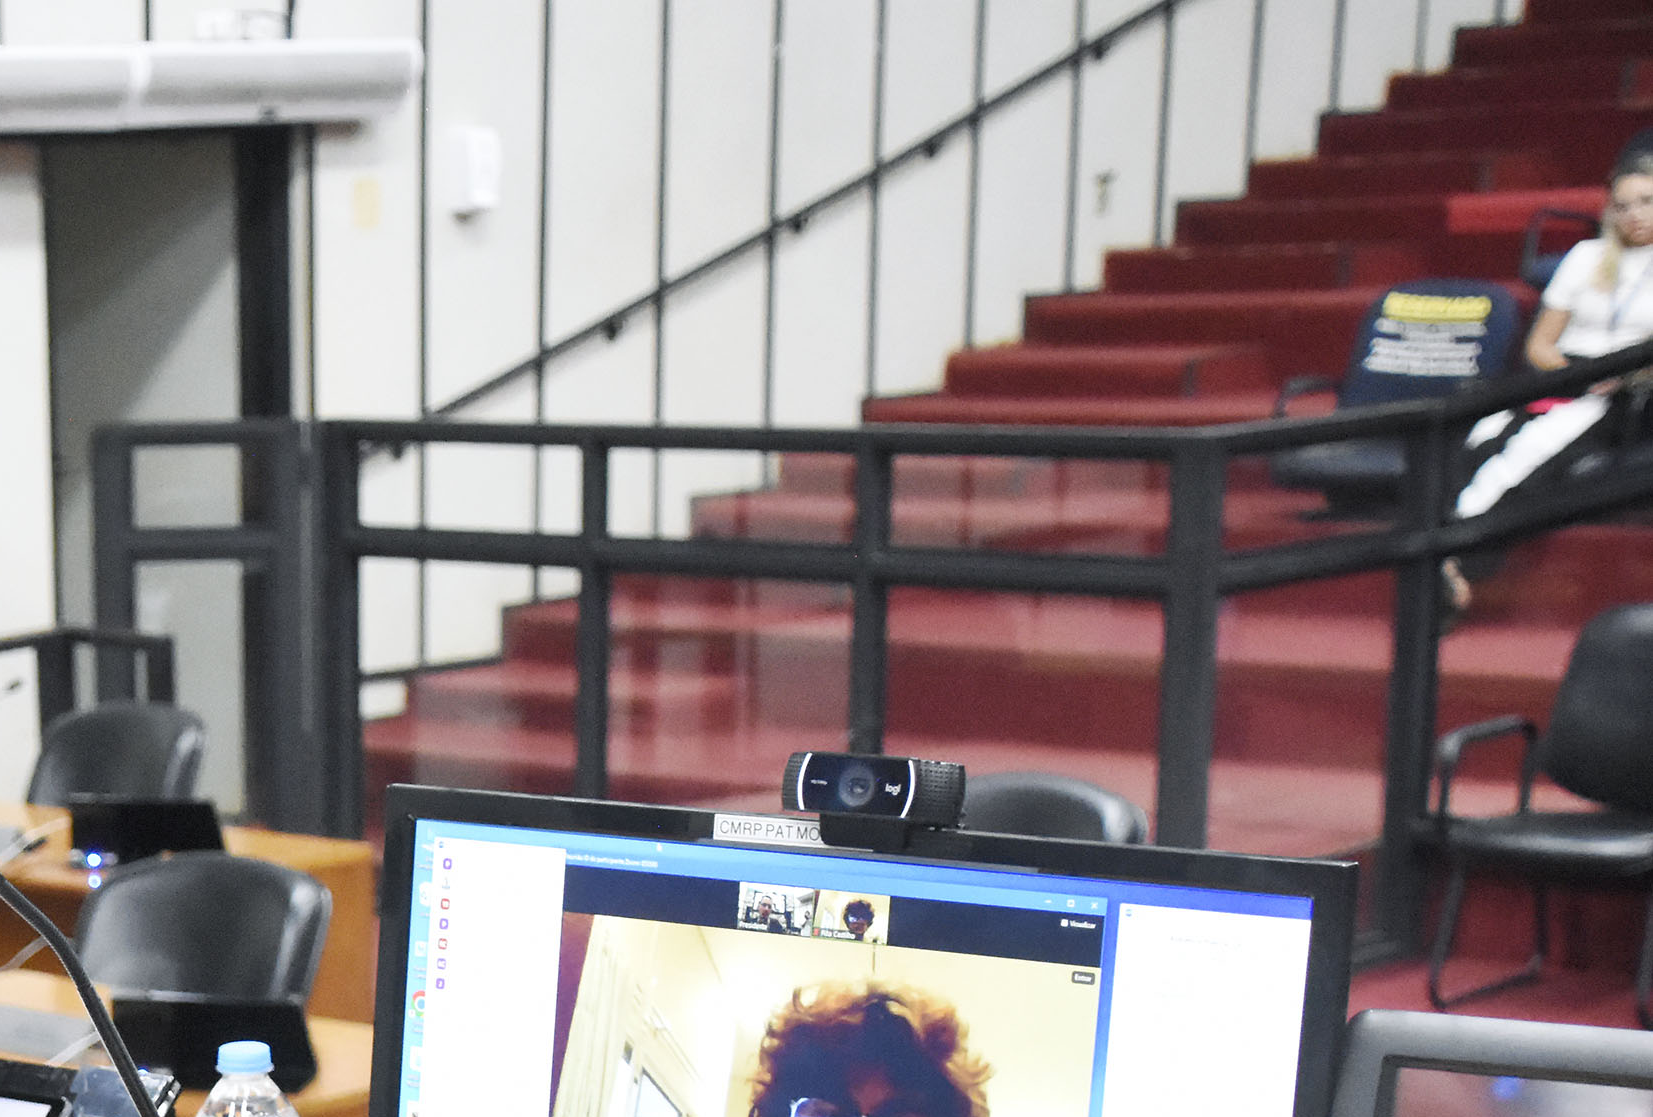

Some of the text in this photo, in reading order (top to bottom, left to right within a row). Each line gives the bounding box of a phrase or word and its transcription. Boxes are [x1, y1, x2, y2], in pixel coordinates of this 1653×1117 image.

[884, 783, 902, 796] logi
[719, 820, 763, 837] CMRP
[766, 824, 794, 840] PAT
